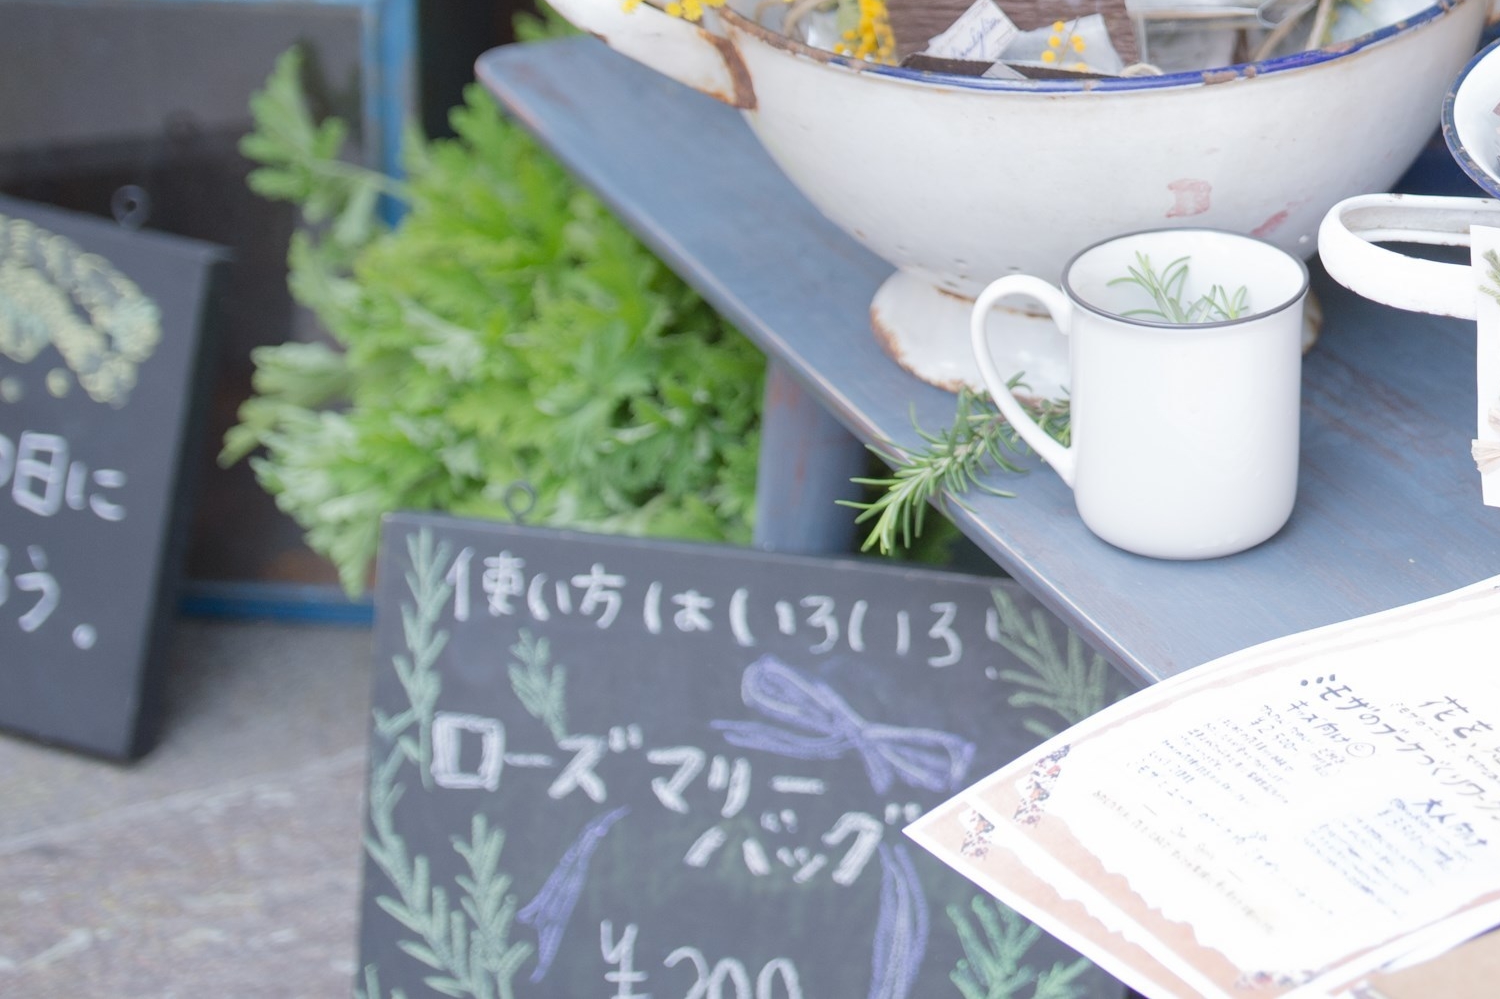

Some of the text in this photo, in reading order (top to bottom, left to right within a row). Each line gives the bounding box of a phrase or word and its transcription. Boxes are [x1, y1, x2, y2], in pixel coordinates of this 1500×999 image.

[0, 543, 98, 651] う。
[431, 713, 826, 818] ローズマリー
